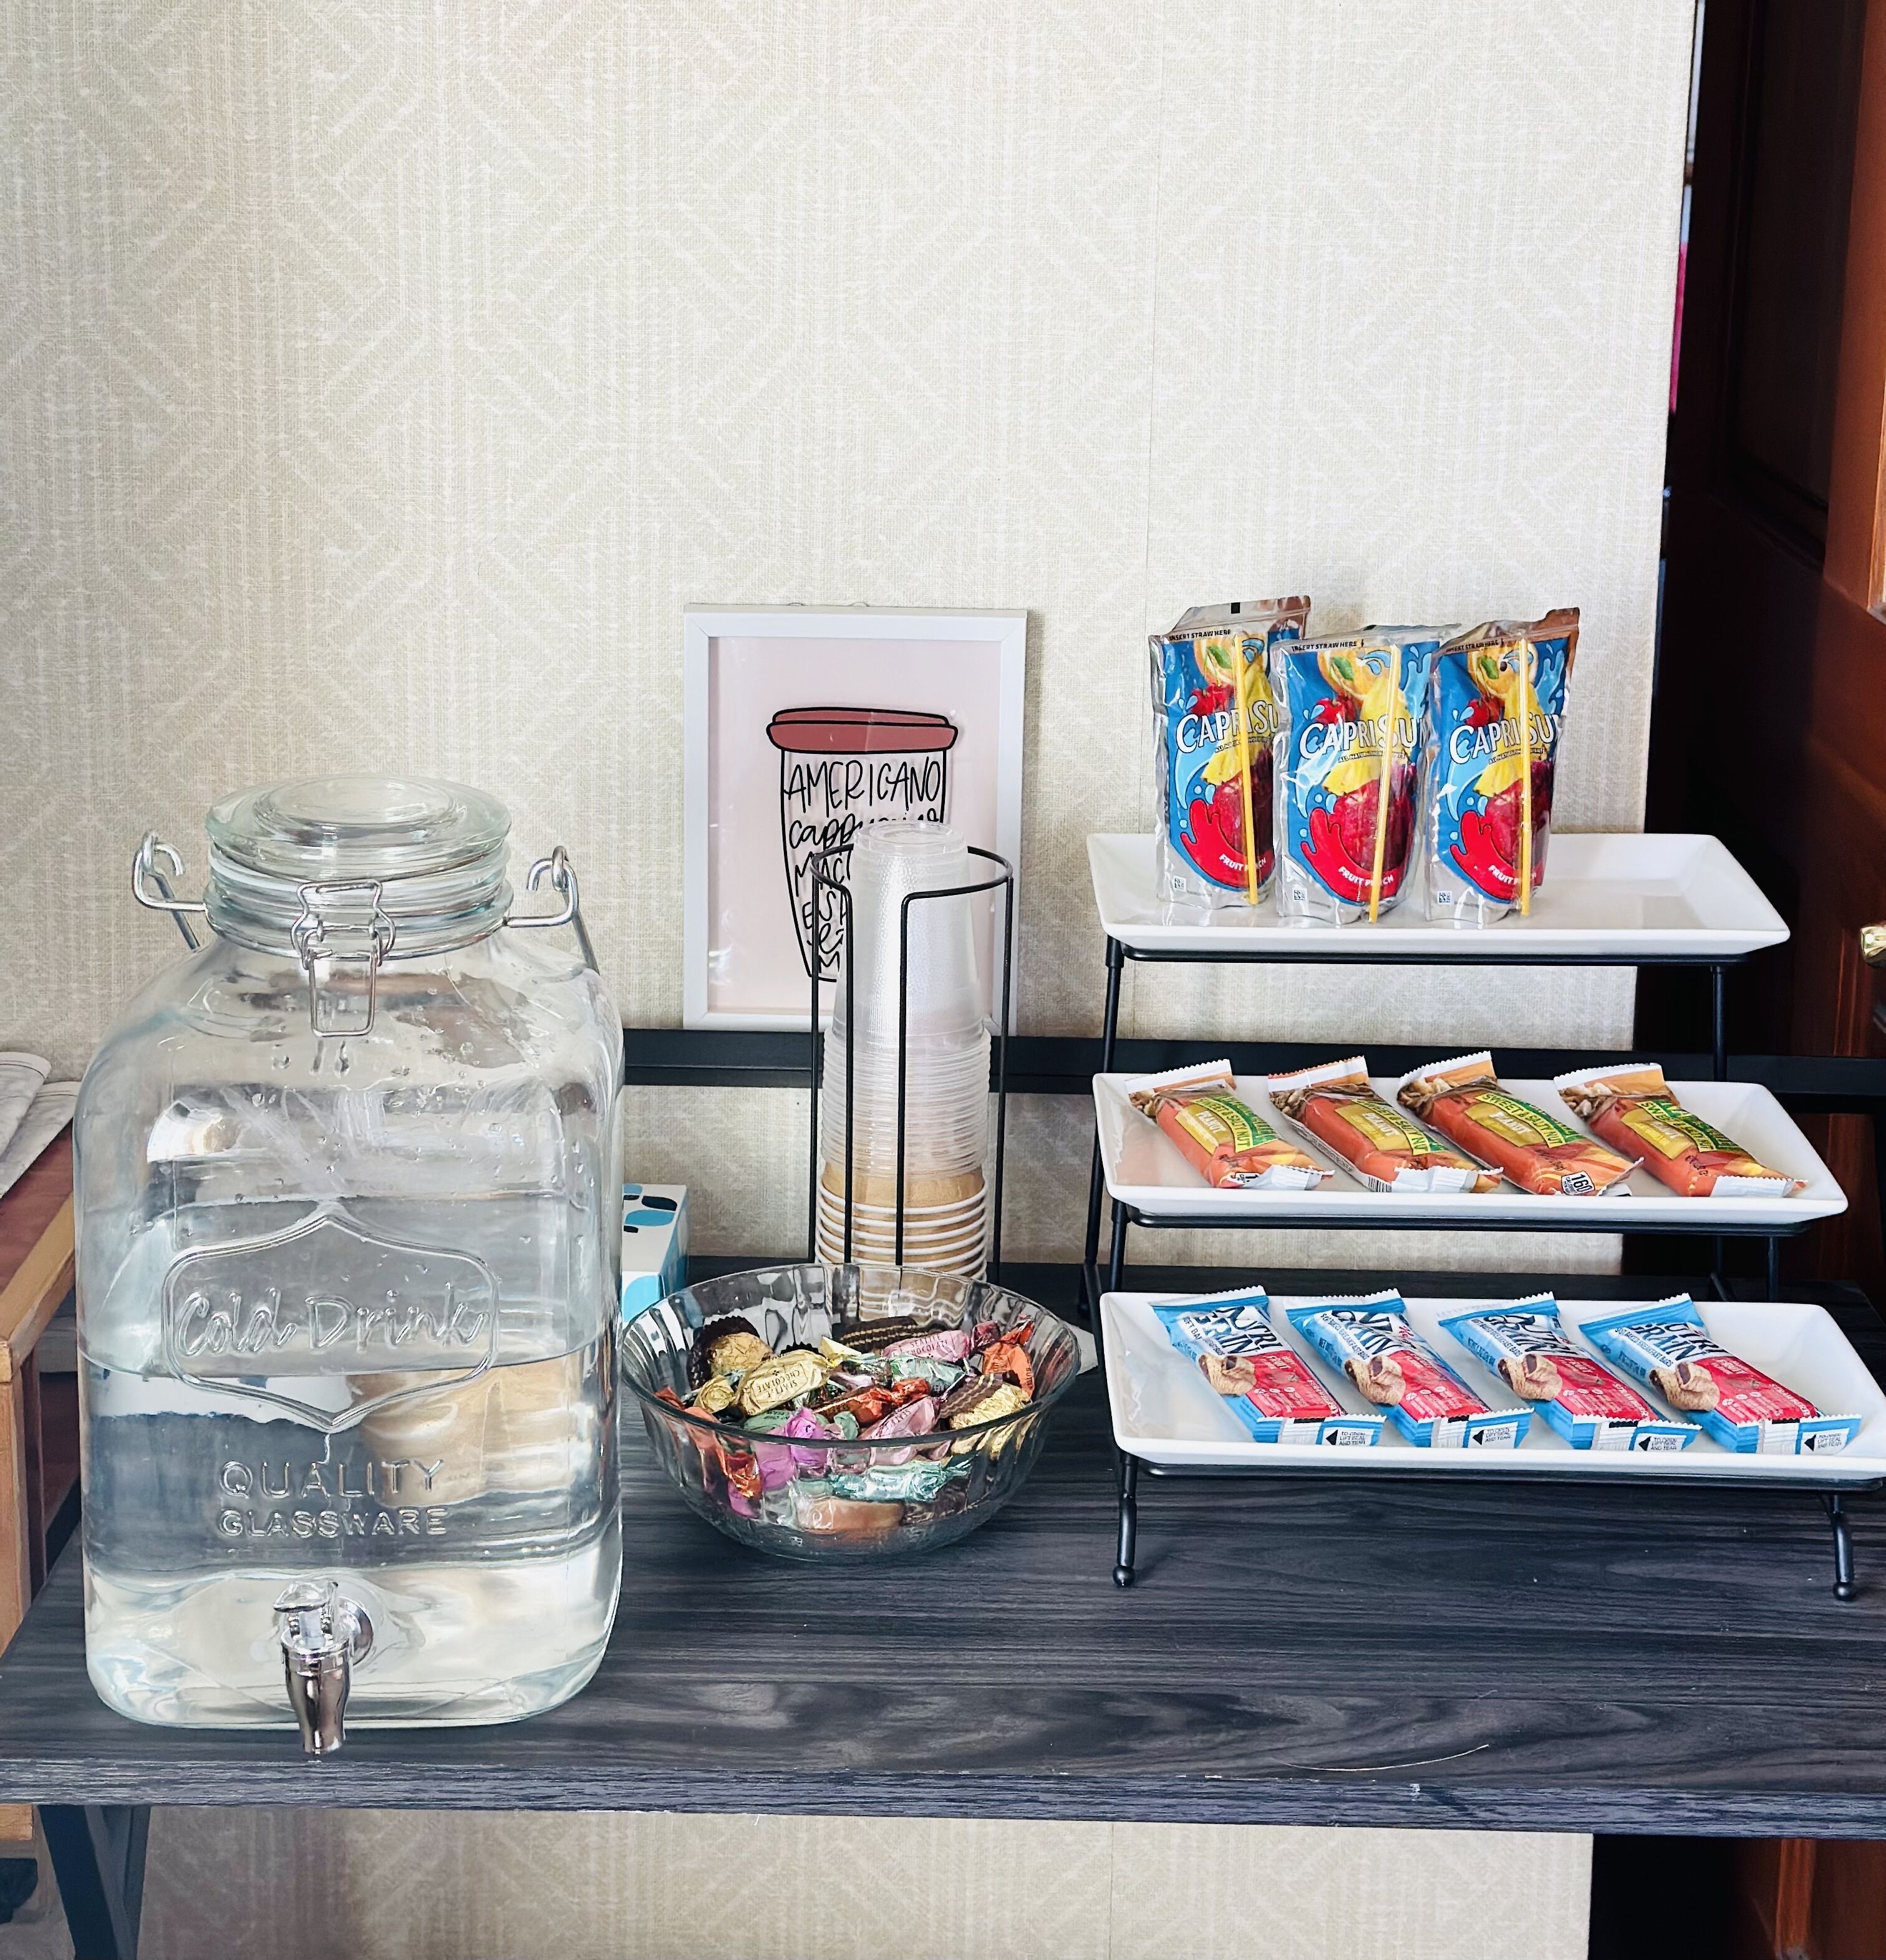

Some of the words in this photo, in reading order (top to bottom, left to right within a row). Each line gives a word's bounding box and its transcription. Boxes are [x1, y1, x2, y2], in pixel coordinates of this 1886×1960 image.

[1191, 630, 1213, 638] STRAW
[783, 756, 941, 818] AMERICANO
[1219, 853, 1244, 871] FRUIT
[1488, 864, 1514, 884] FRUIT
[1338, 866, 1364, 885] FRUIT
[1365, 874, 1394, 886] PCH
[1196, 1098, 1229, 1116] SWEET
[1227, 1115, 1247, 1131] SALTY
[1237, 1131, 1250, 1147] NUT
[1482, 1094, 1520, 1113] SWEET
[1528, 1114, 1552, 1132] SALTY
[1547, 1131, 1563, 1145] NUT
[1411, 1136, 1428, 1152] NUT
[1572, 1174, 1593, 1192] 160
[178, 1287, 297, 1356] Cold
[306, 1283, 489, 1353] Drink
[220, 1459, 444, 1498] QUALITY
[220, 1508, 448, 1537] GLASSWARE
